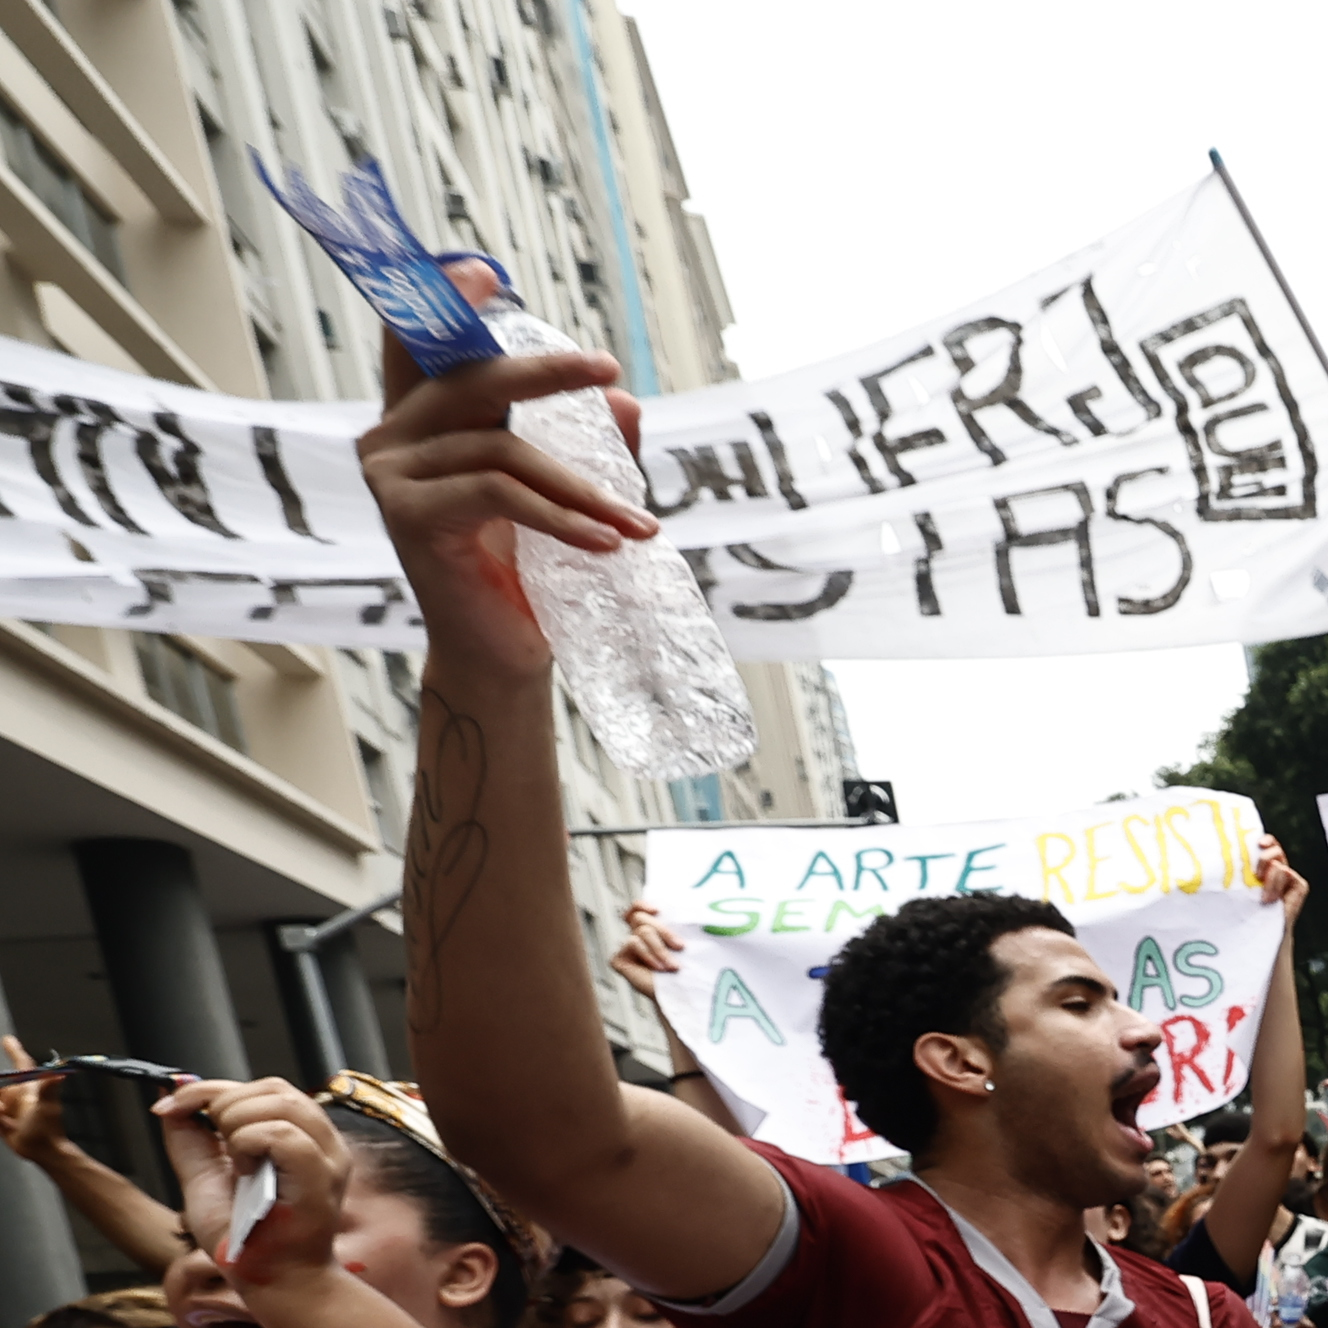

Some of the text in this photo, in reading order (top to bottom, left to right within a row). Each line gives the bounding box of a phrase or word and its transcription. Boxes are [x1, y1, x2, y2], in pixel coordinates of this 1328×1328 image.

[692, 850, 746, 889] A
[797, 844, 1007, 892] ARTE
[709, 967, 785, 1045] A
